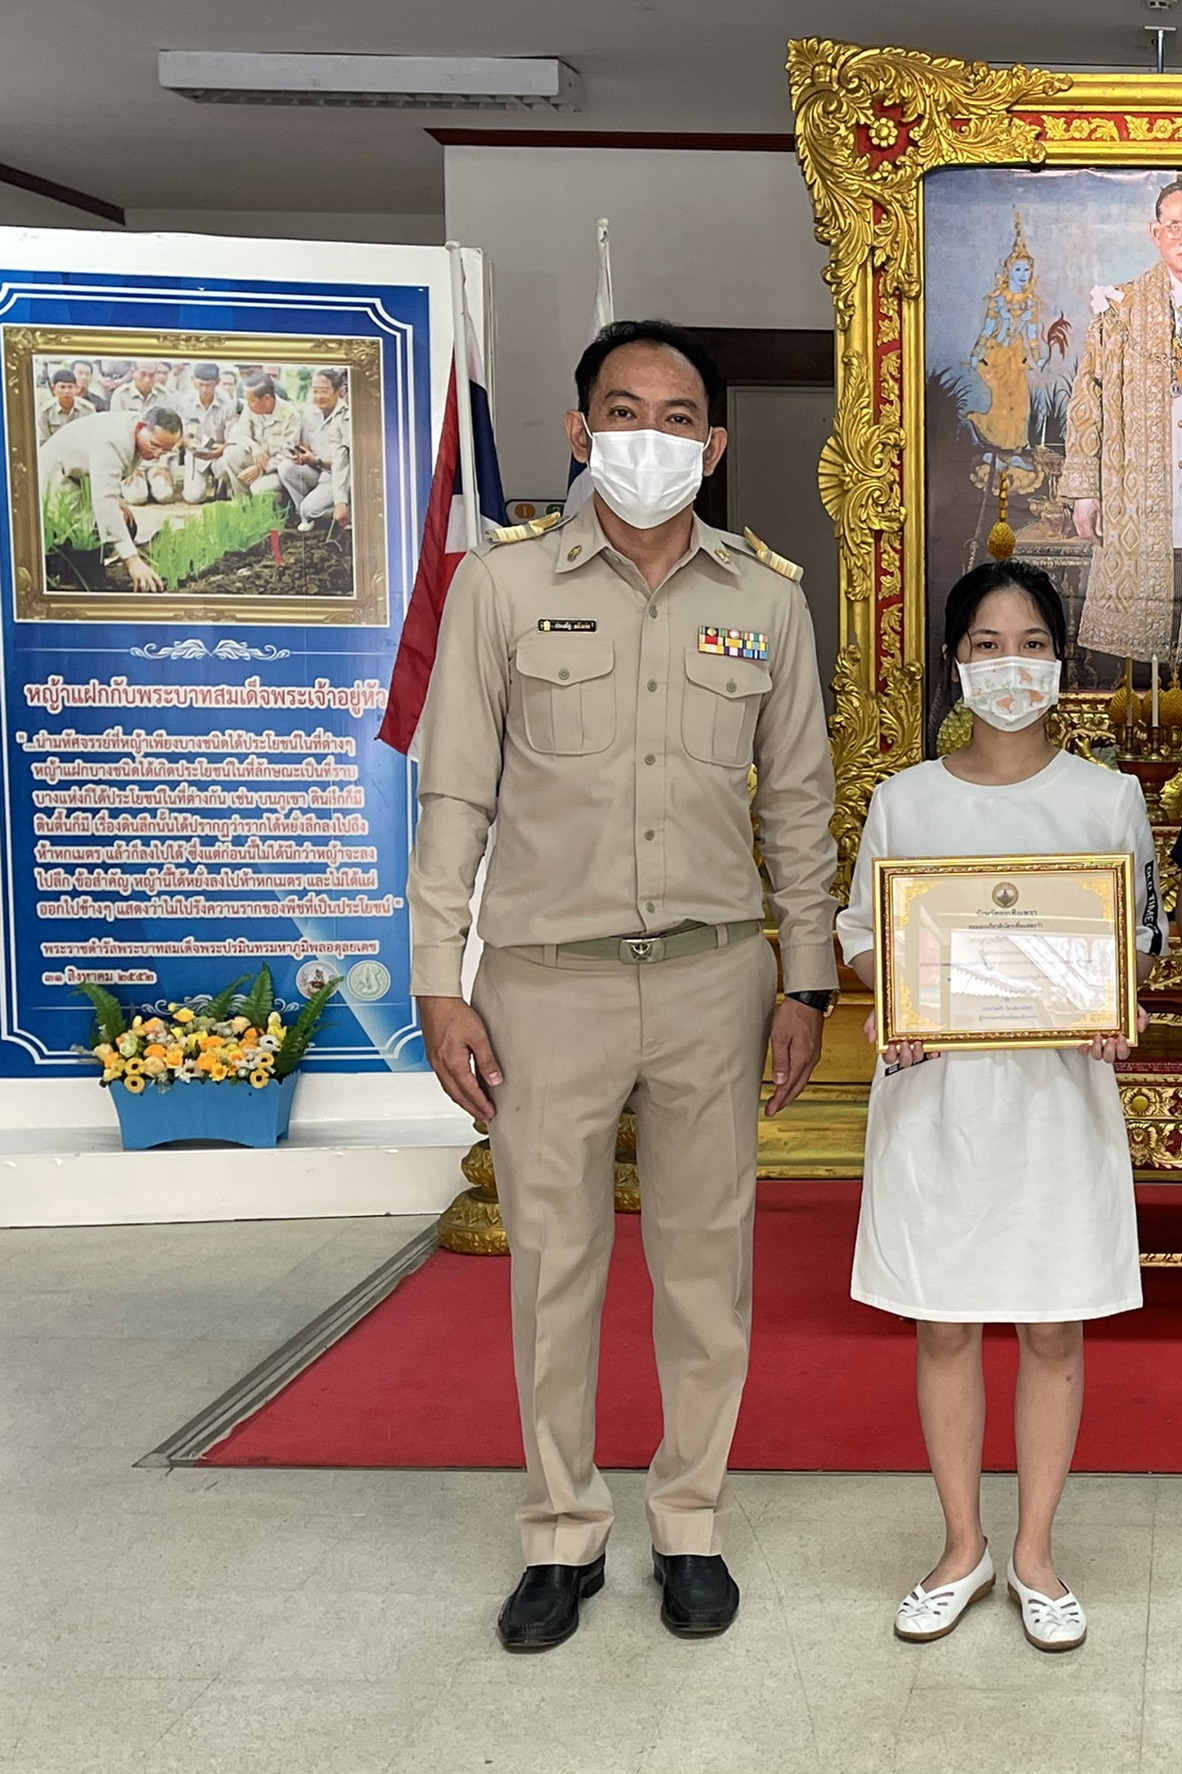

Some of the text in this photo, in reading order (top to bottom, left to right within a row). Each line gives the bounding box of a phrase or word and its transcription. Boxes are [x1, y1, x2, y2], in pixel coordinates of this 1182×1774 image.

[25, 677, 387, 714] หญ้าแฝกกับพระบาทสมเด็จพระเจ้าอยู่หัว
[231, 788, 255, 808] เช่น
[258, 792, 307, 812] บนภูเขา
[35, 842, 102, 862] ห้าหกเมตร
[105, 842, 185, 862] แล้วก็ลงไปได้
[36, 866, 377, 894] ไปลึก ข้อสำคัญ หญ้านี้ได้หยั่งลงไปห้าหกเมตร และไม่ได้แผ่
[38, 897, 114, 921] ออกไปข้างๆ
[1144, 892, 1157, 923] TIME
[66, 967, 113, 984] สิงหาคม
